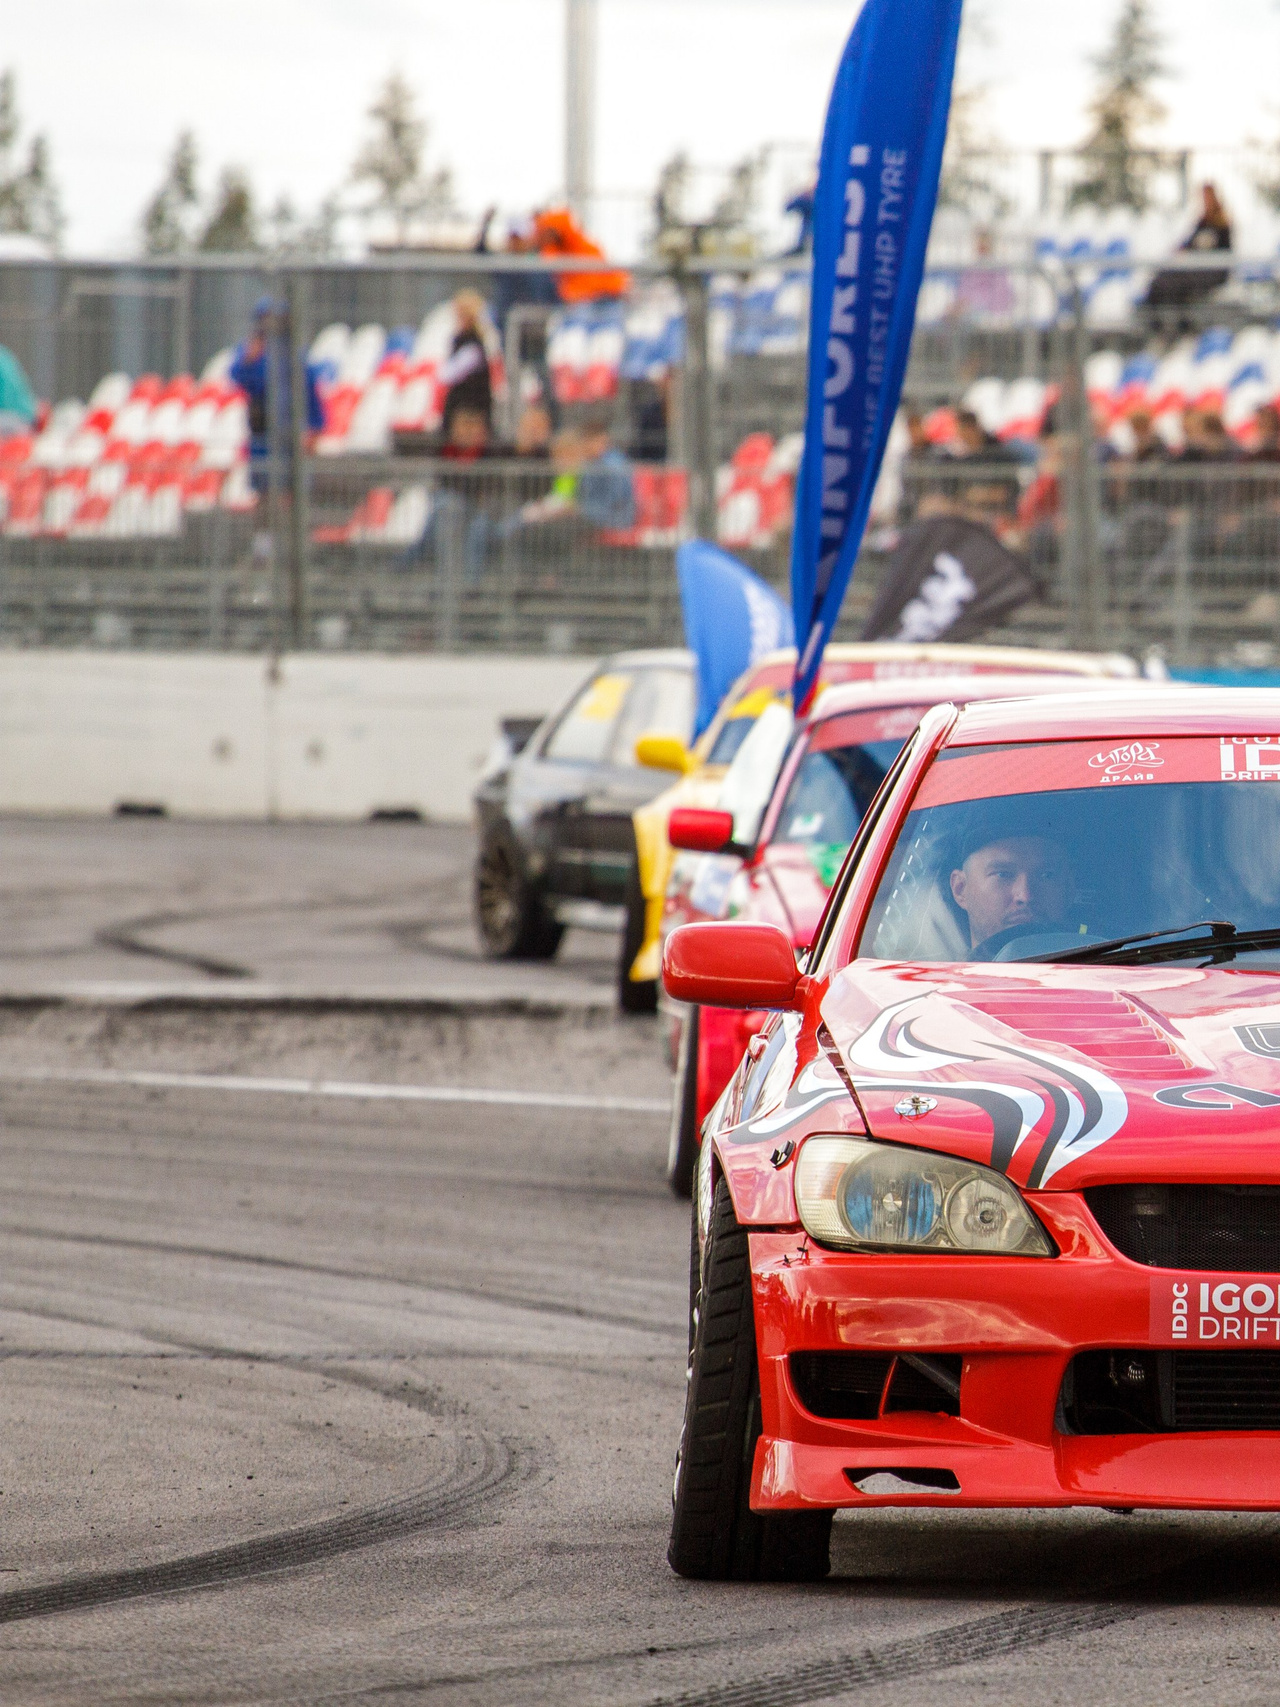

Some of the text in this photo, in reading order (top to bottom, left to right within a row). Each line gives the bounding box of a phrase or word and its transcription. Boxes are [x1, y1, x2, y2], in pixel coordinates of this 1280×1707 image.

[875, 148, 906, 224] TYRE
[869, 233, 896, 299] UHP
[1100, 773, 1154, 783] ДРАЙВ
[1172, 1283, 1188, 1339] IDDC
